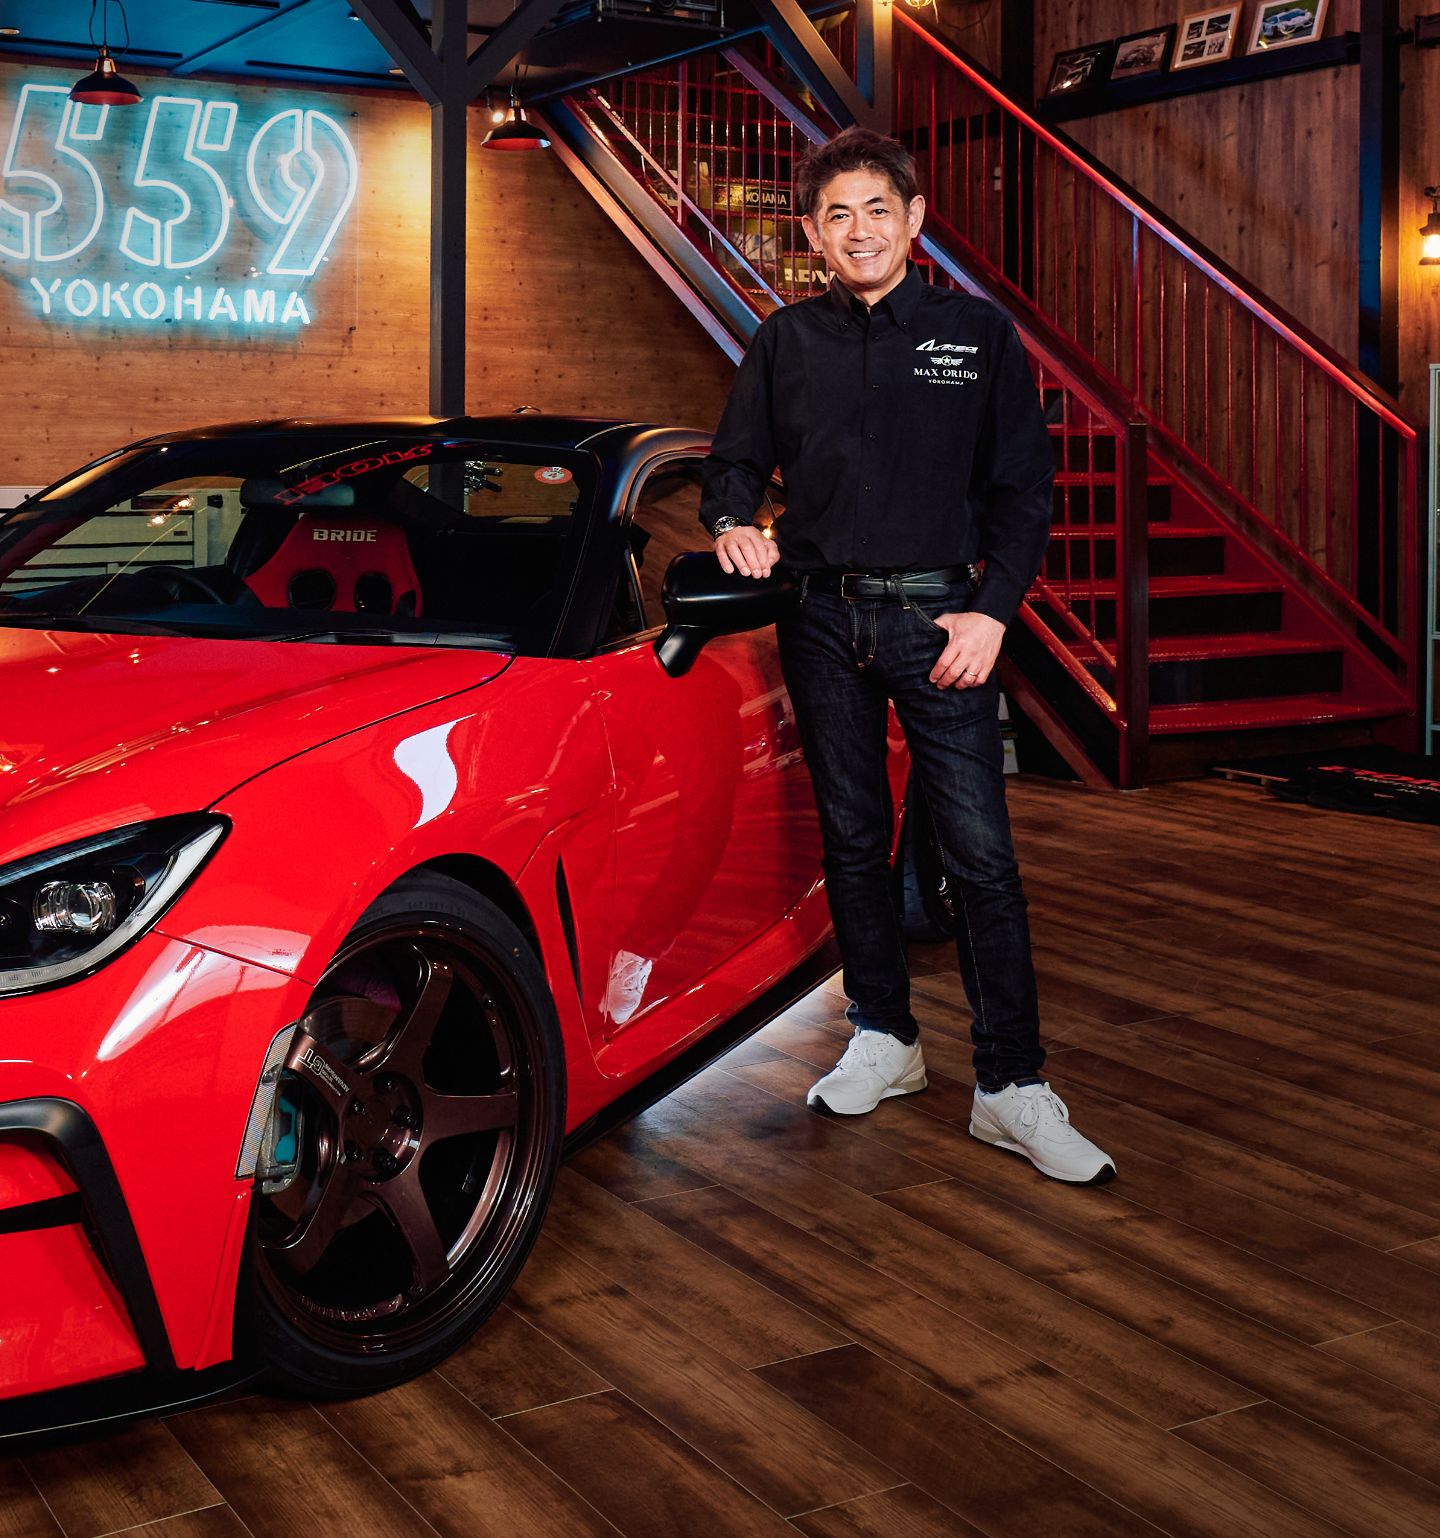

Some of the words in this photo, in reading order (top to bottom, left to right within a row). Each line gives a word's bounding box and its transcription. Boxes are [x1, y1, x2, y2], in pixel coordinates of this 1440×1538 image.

[30, 276, 311, 325] YOKOHAMA
[913, 367, 939, 377] MAX
[942, 369, 978, 380] ORIDO
[312, 528, 378, 543] BRIDE
[296, 1047, 326, 1077] GT
